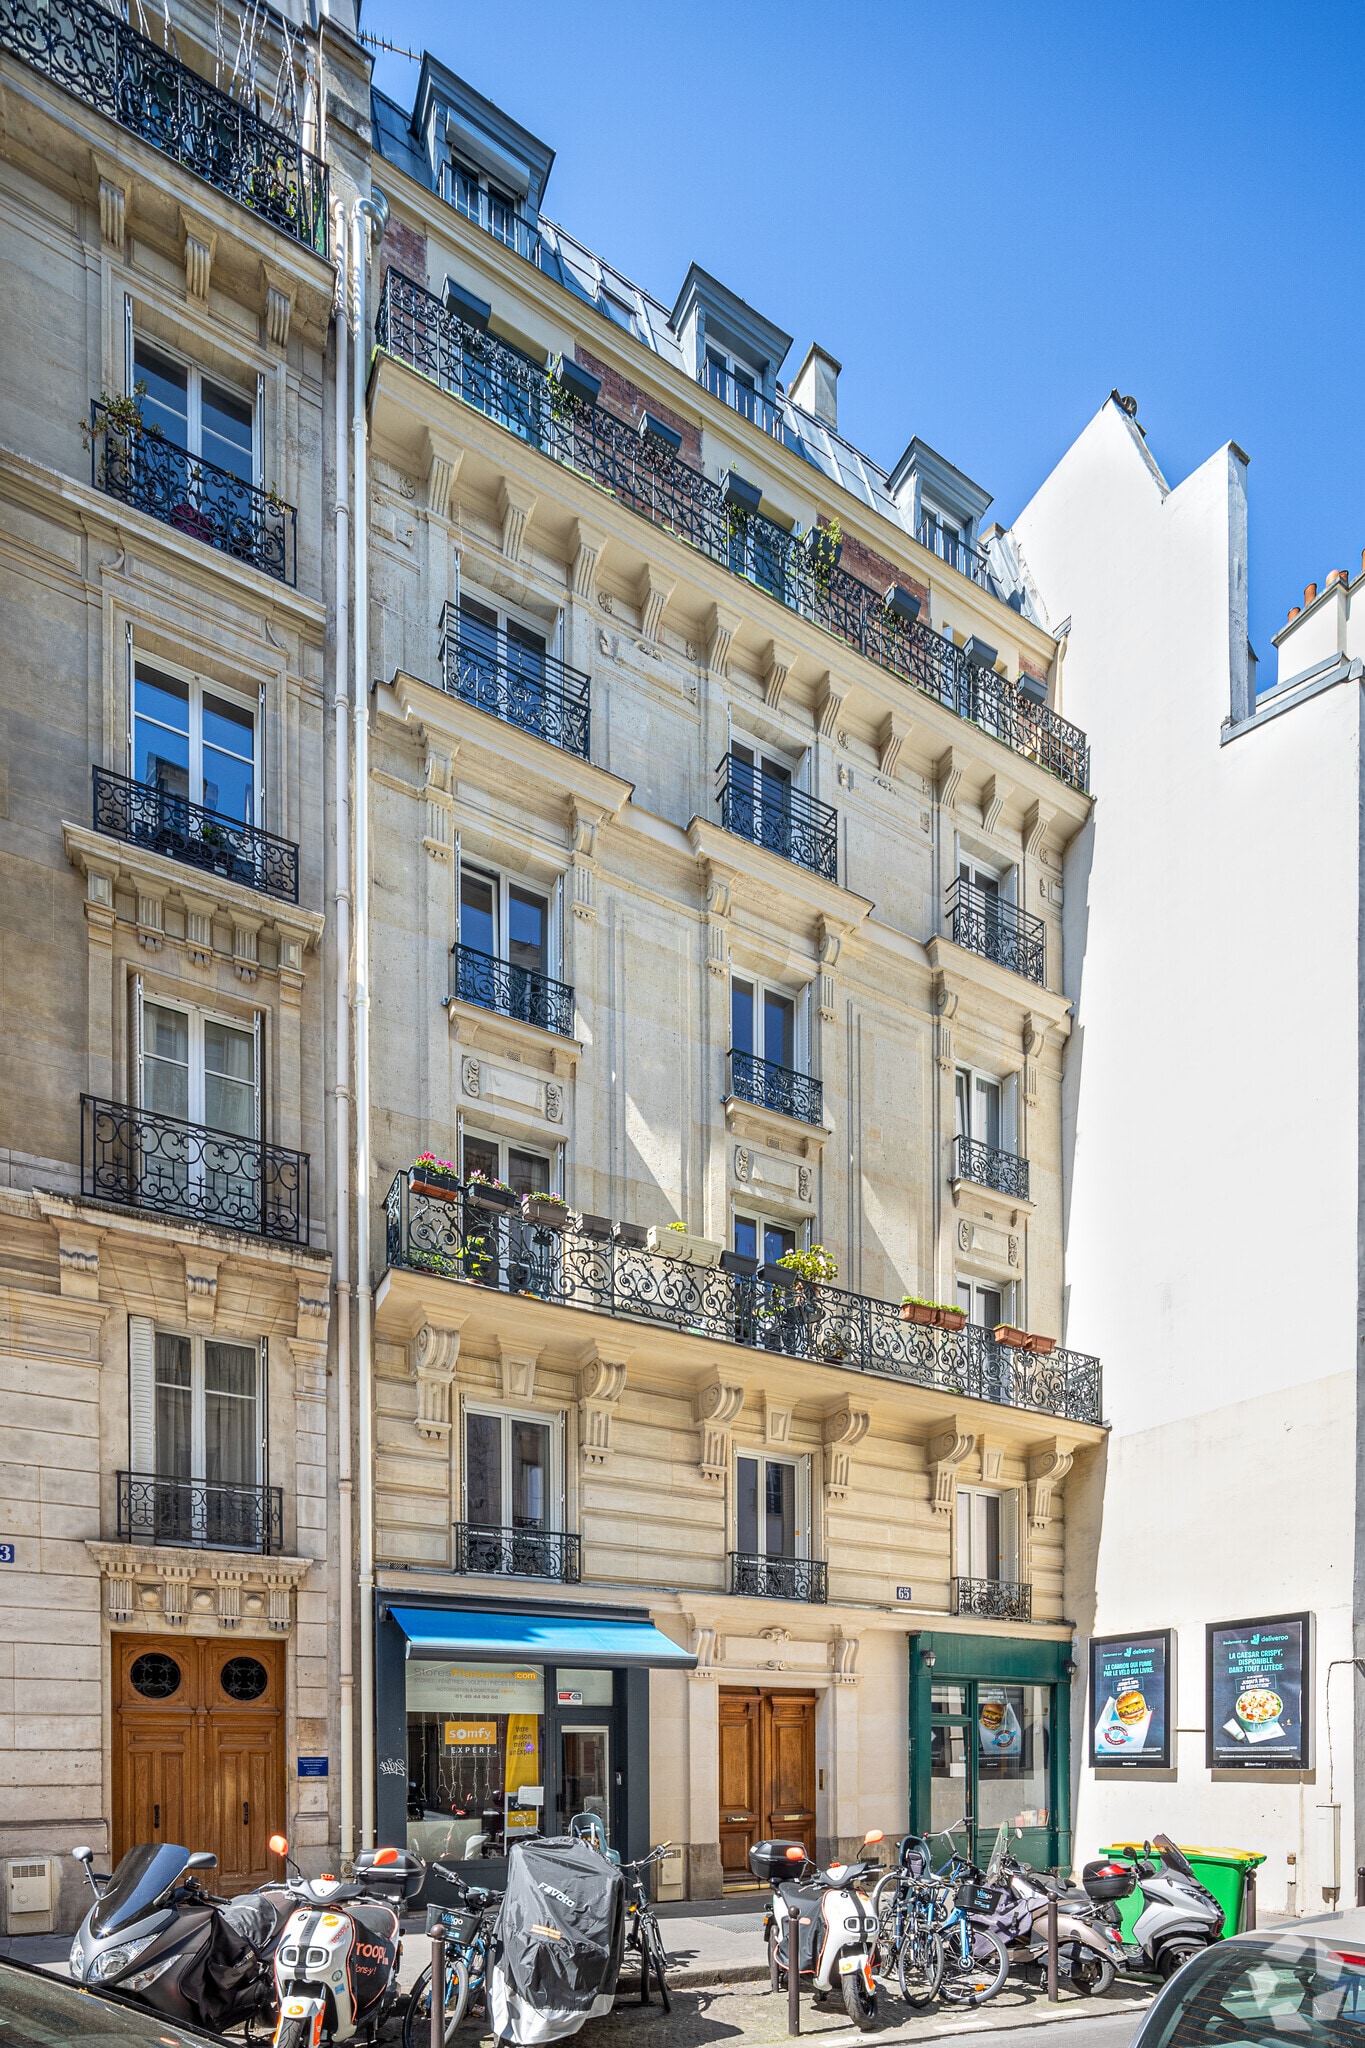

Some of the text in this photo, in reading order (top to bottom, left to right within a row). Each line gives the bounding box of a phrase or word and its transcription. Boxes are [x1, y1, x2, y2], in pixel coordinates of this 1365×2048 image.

[898, 1587, 910, 1600] 65
[1236, 1650, 1260, 1658] CAESAR
[1238, 1656, 1274, 1666] DISPONIBLE
[1244, 1664, 1260, 1672] TOUT
[1262, 1662, 1284, 1672] LUTÈCE.
[449, 1727, 492, 1740] somfy
